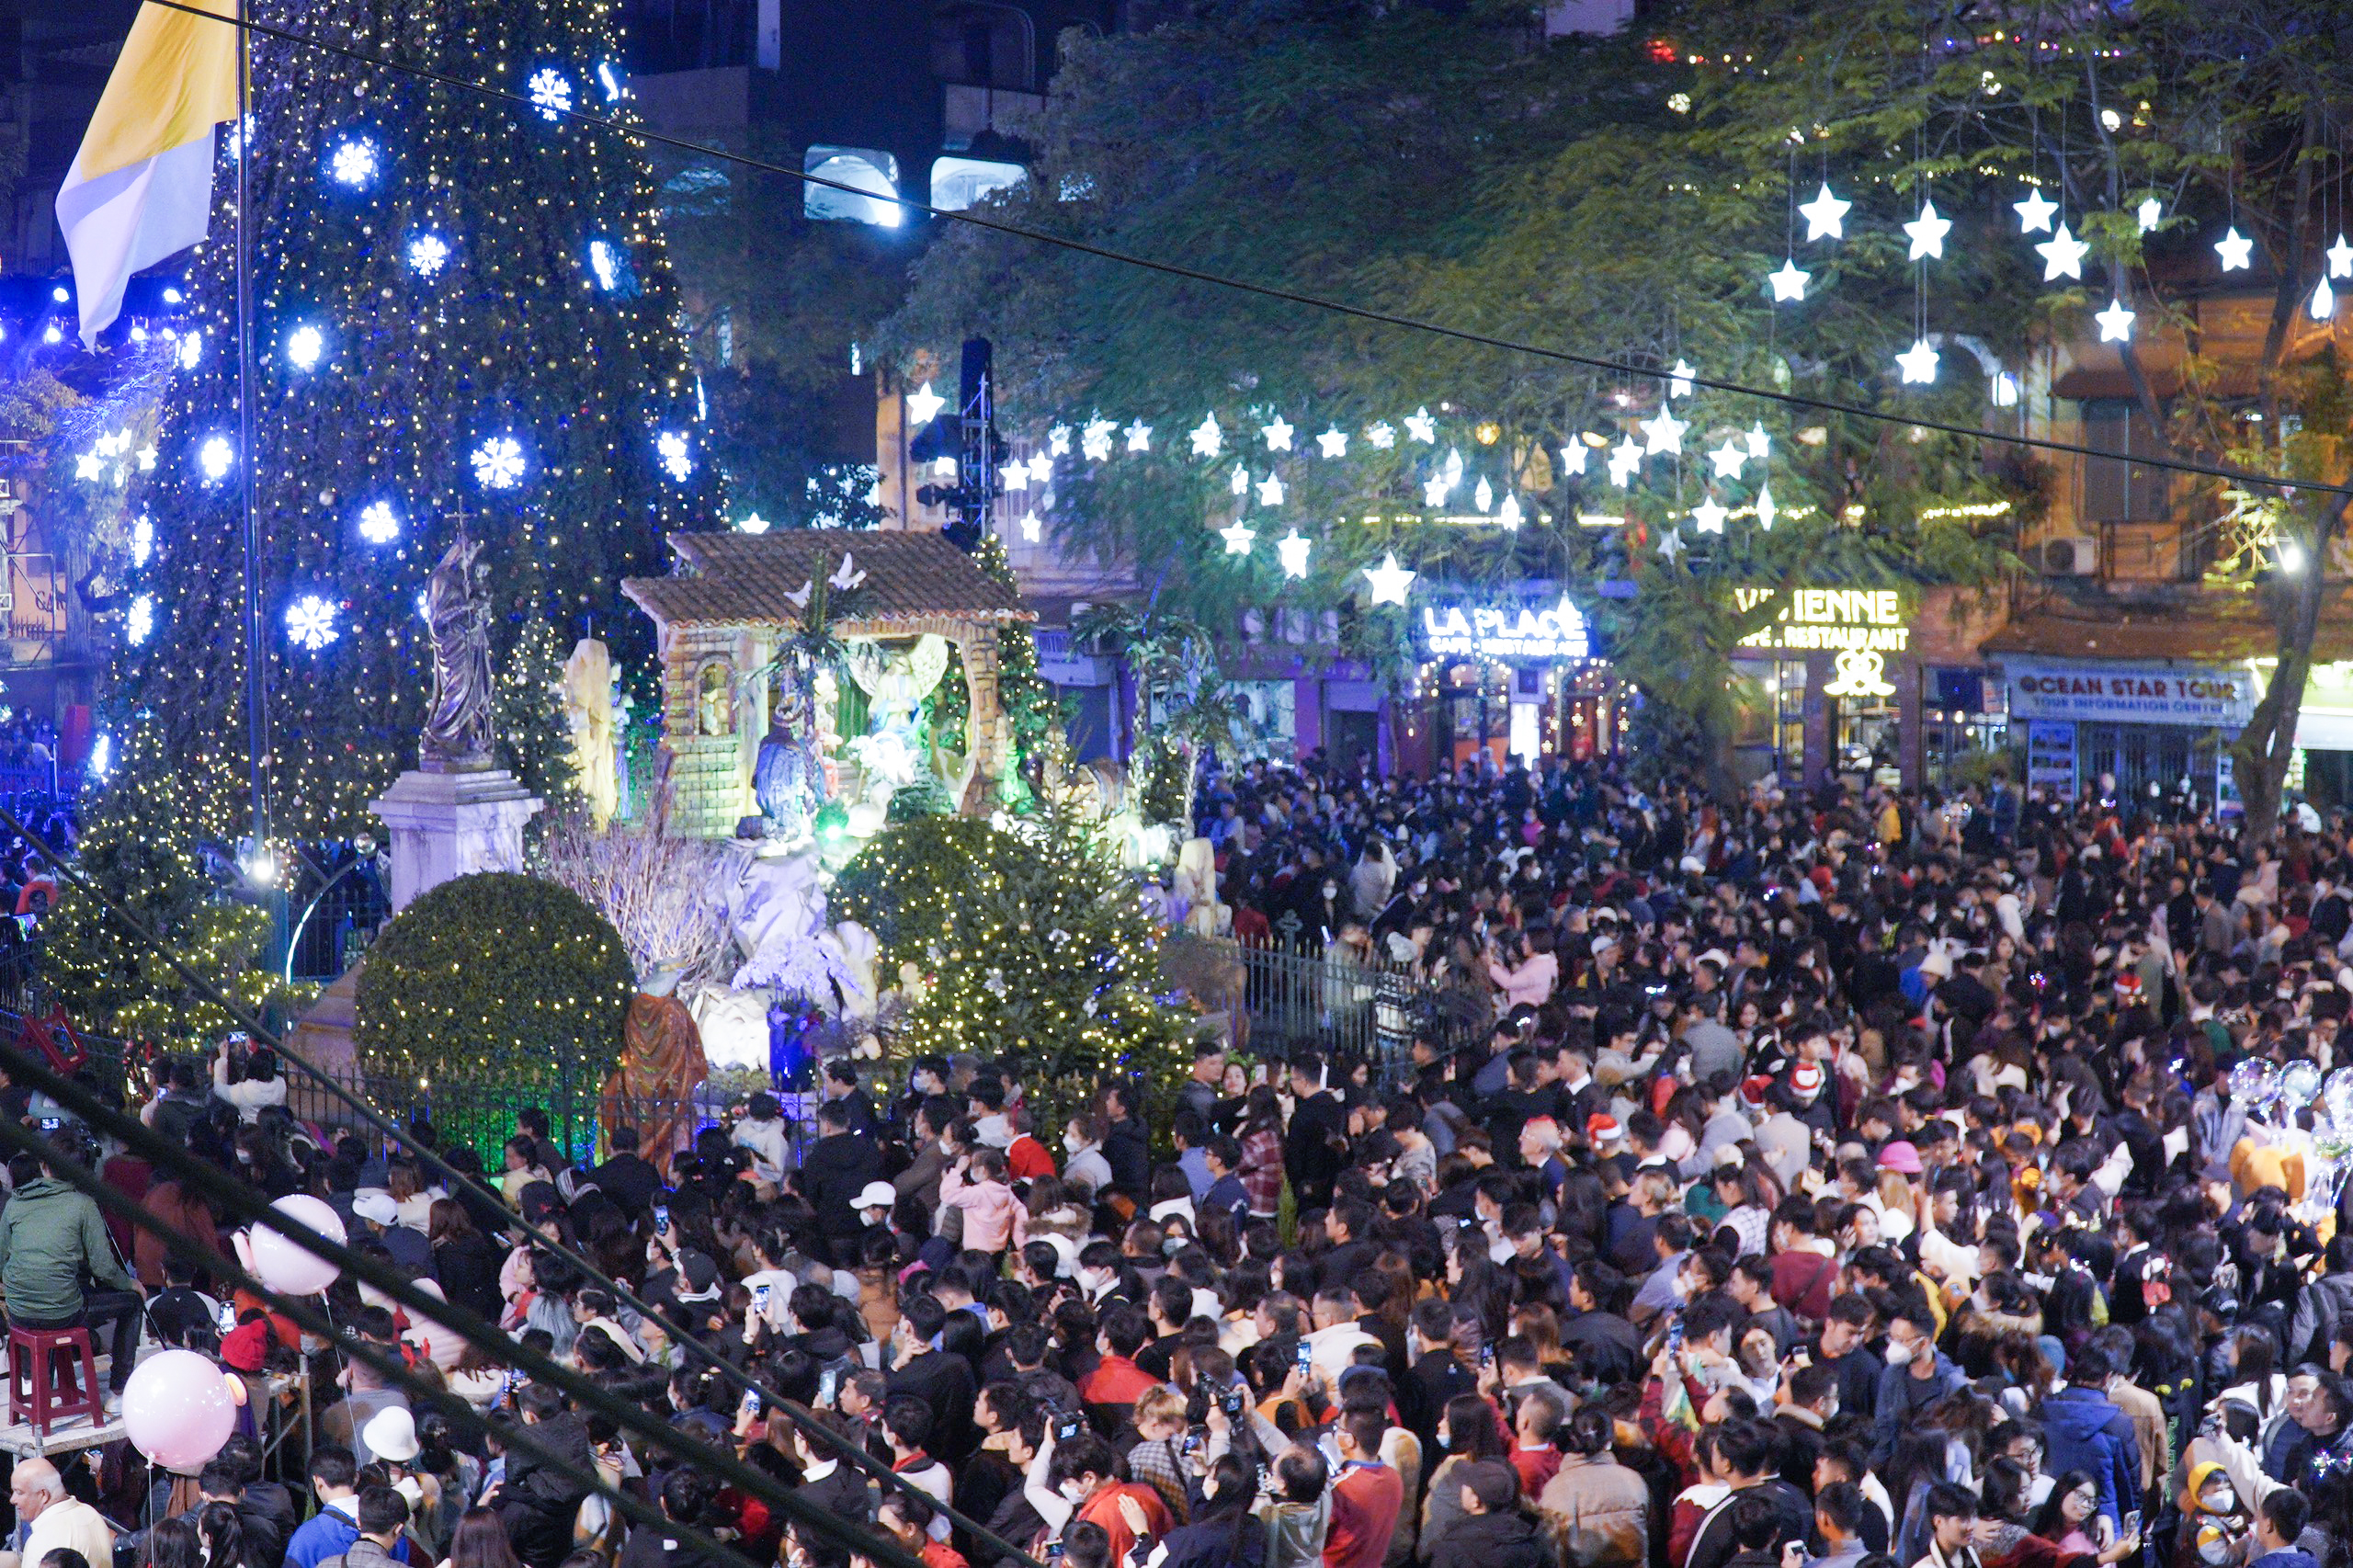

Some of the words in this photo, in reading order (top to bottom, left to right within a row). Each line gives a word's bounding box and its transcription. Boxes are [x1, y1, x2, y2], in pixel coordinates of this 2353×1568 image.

[1425, 608, 1472, 637] LA
[1473, 608, 1588, 641] PLACE
[1783, 625, 1910, 651] RESTAURANT
[2019, 675, 2103, 696] OCEAN
[2110, 677, 2167, 698] STAR
